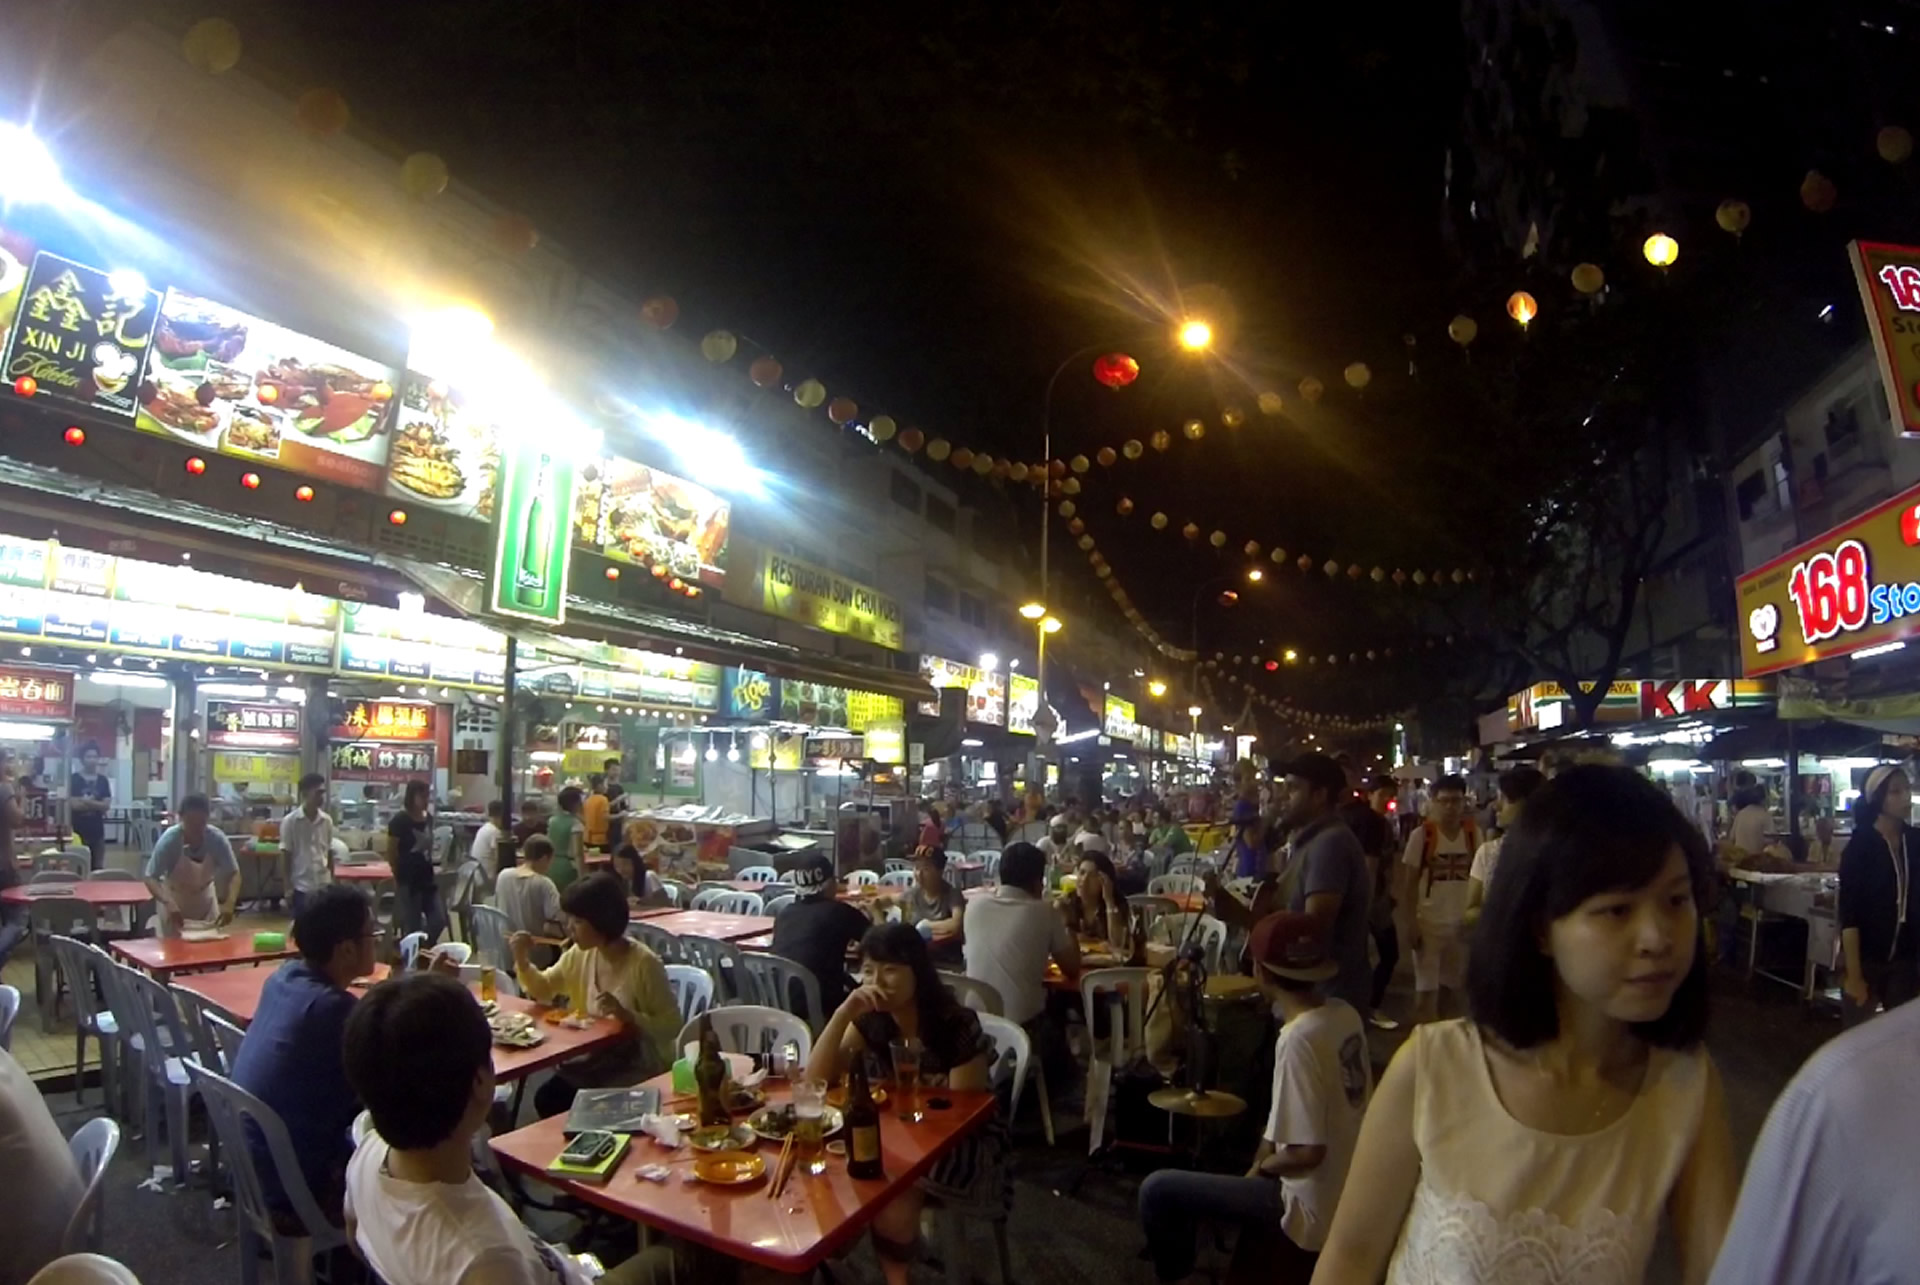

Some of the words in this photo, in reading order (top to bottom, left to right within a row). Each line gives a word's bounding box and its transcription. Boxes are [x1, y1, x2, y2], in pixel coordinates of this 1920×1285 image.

[22, 326, 63, 355] XIN
[66, 341, 86, 362] JI
[1788, 539, 1869, 644] 168
[1640, 680, 1721, 718] KK
[796, 867, 824, 885] NYC
